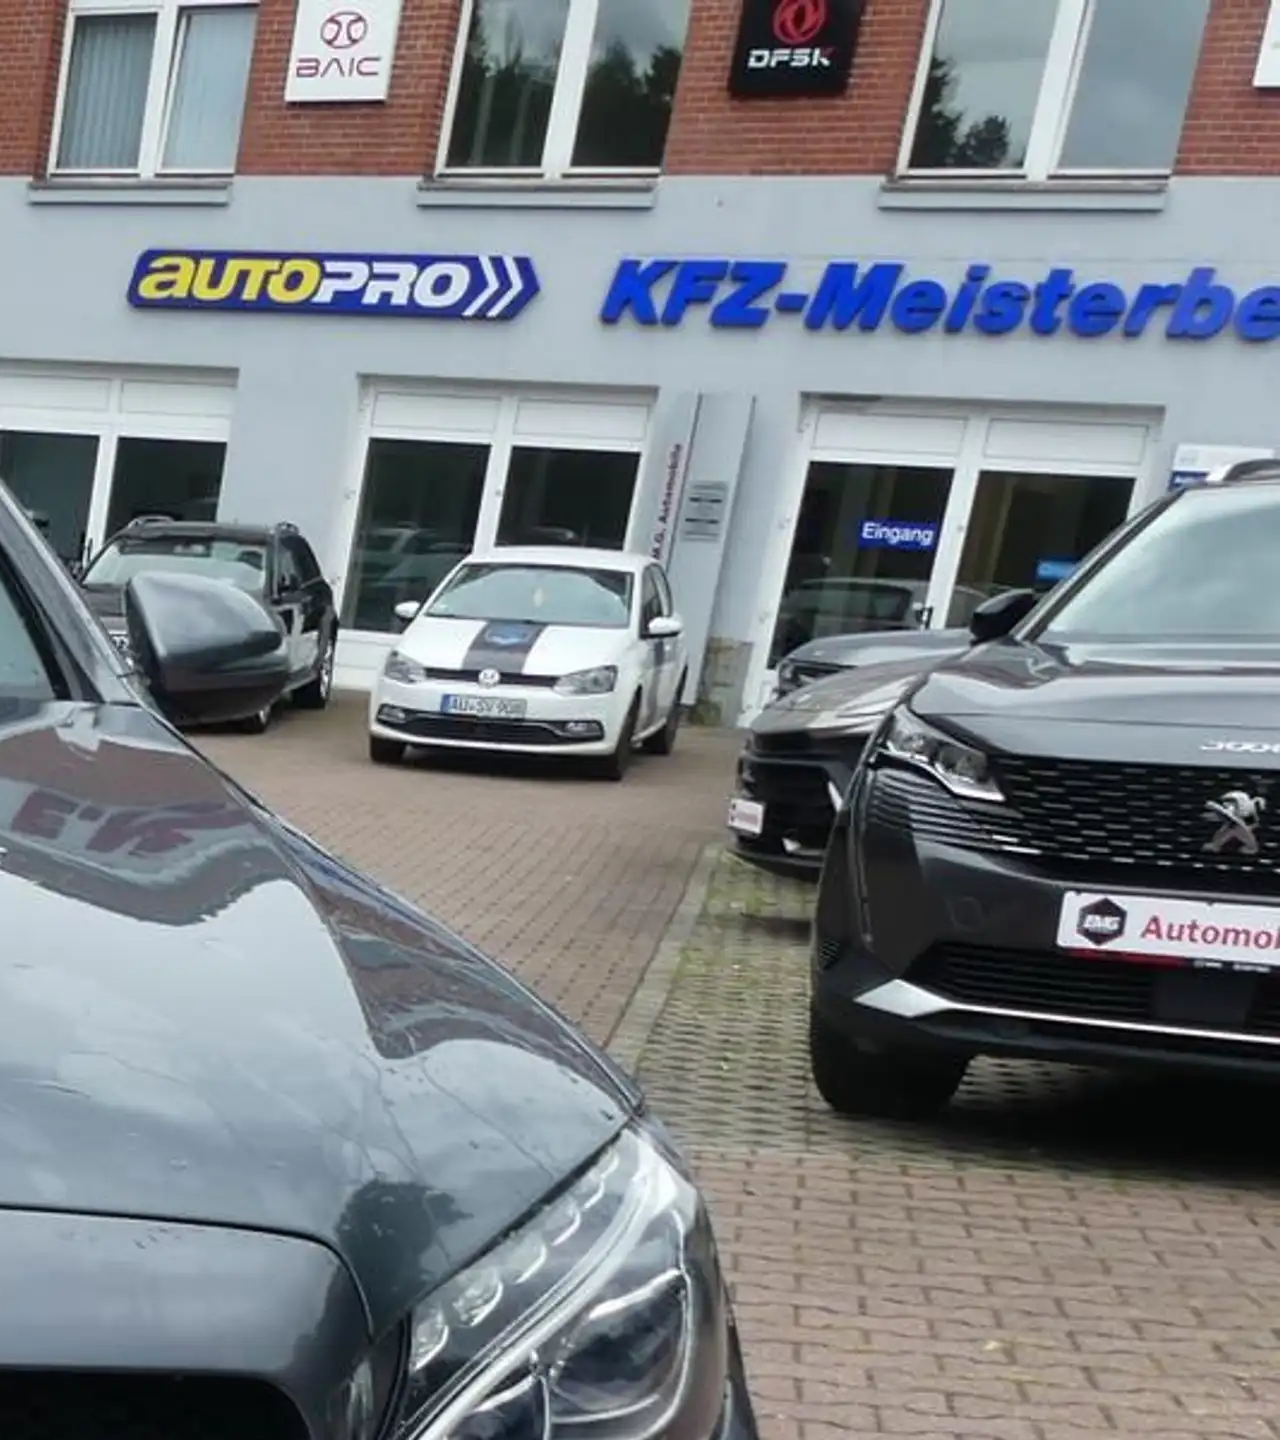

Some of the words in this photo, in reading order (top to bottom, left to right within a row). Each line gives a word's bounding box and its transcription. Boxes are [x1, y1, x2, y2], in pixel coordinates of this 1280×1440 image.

[296, 57, 382, 78] BAIC
[747, 47, 832, 68] DFSK
[862, 522, 934, 546] Eingang
